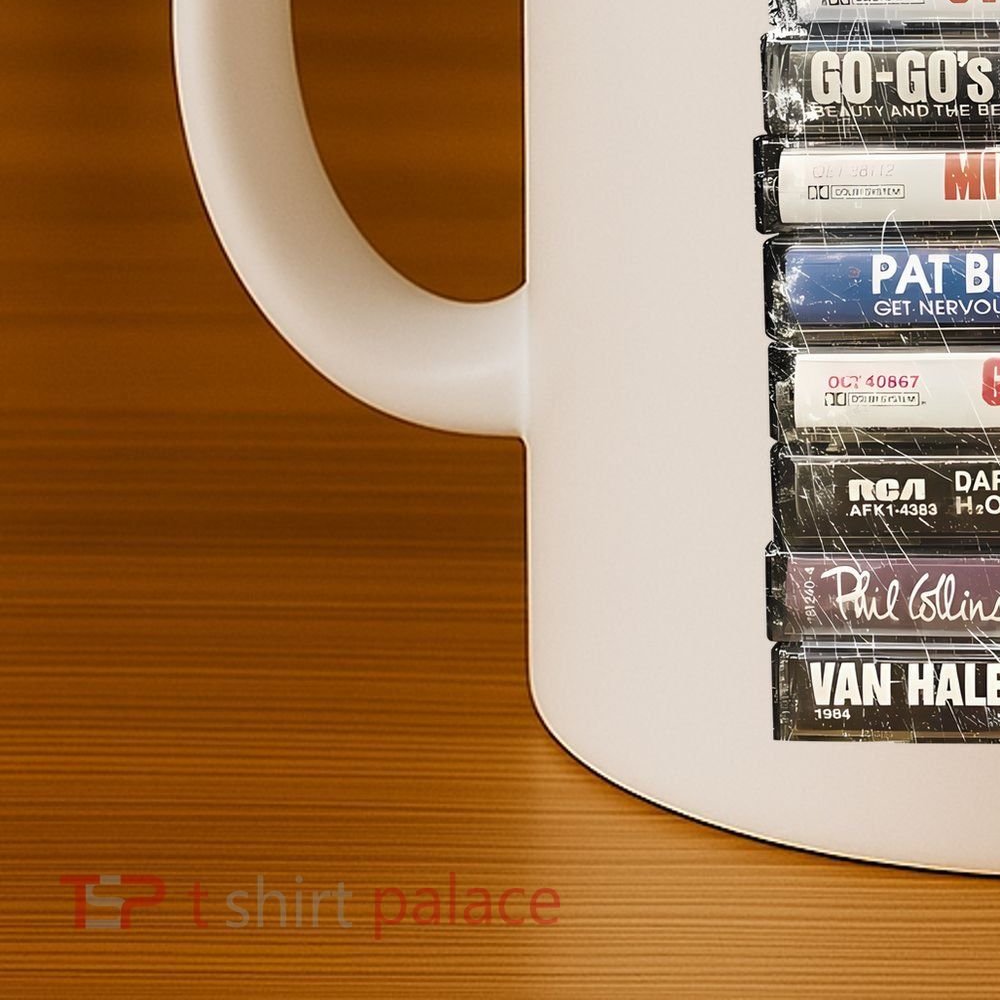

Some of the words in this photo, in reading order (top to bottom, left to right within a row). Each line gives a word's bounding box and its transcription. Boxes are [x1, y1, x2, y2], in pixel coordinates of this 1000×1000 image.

[814, 103, 884, 119] BEAUTY
[890, 103, 930, 119] AND
[934, 103, 971, 119] THE
[871, 253, 950, 295] PAT
[873, 299, 911, 316] GET
[865, 375, 919, 389] 40867
[848, 478, 926, 501] RCA
[850, 502, 938, 517] AFK1-4383
[821, 565, 899, 622] Phil
[810, 661, 892, 706] VAN
[814, 708, 851, 721] 1984
